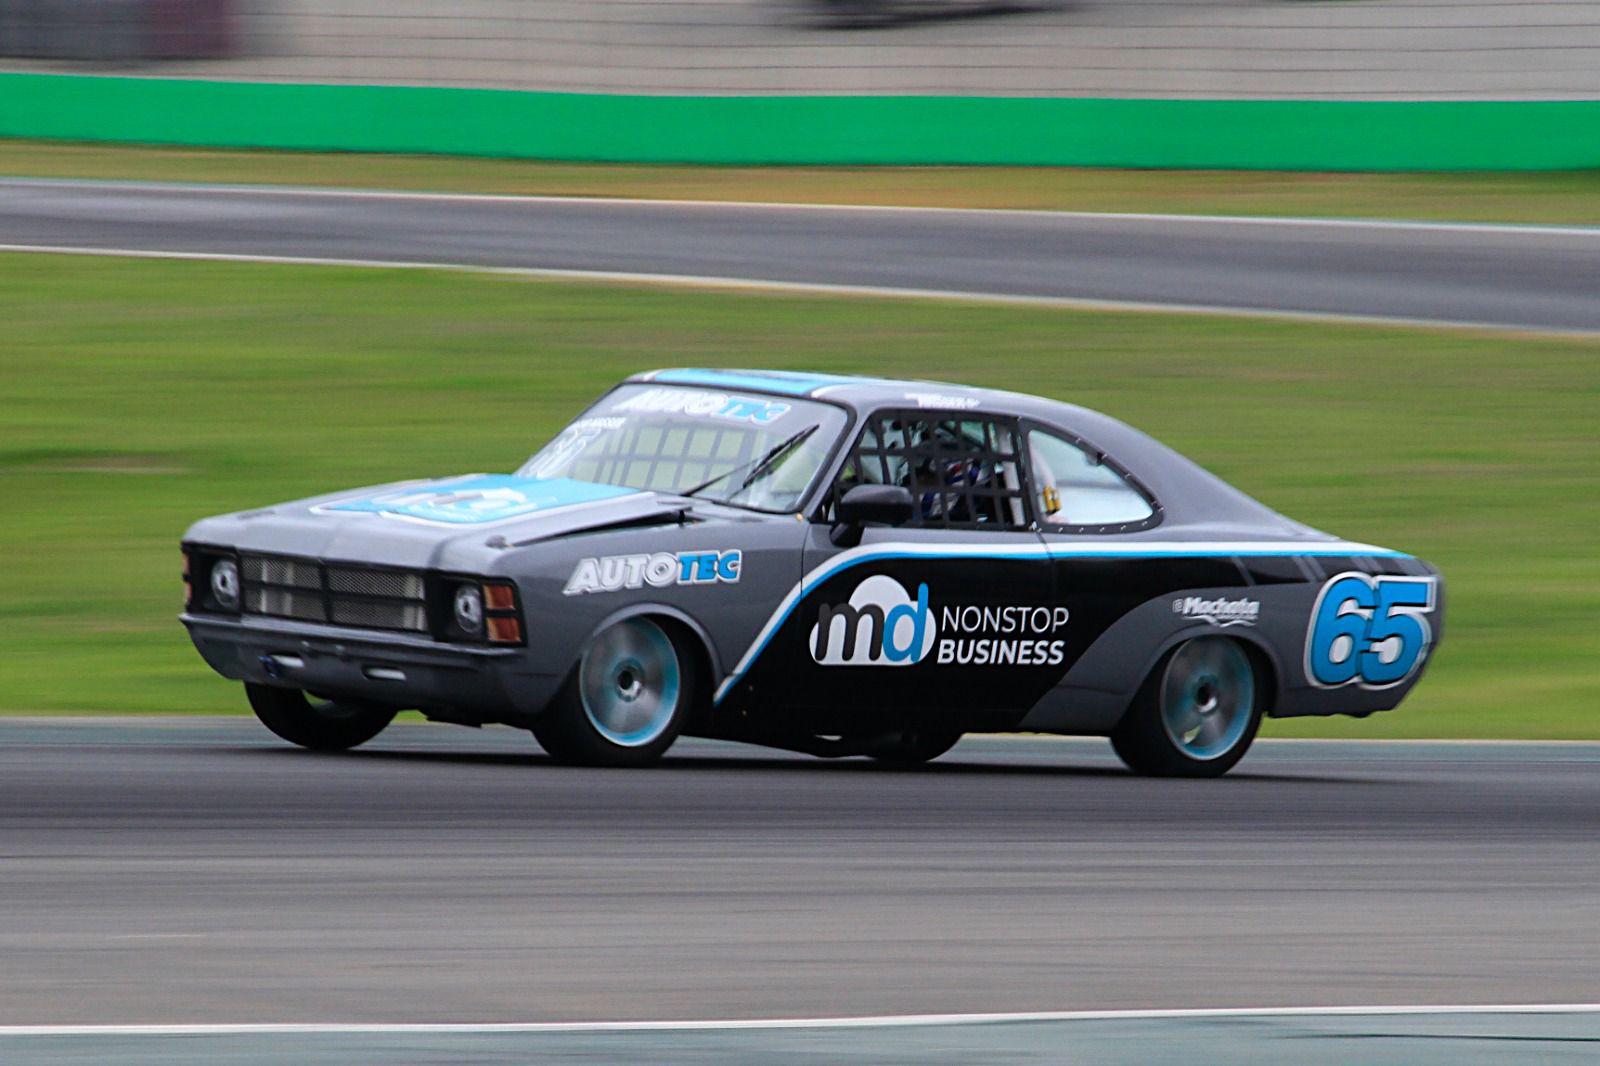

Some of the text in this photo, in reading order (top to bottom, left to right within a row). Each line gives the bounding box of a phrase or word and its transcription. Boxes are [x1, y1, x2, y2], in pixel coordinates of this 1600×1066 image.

[562, 549, 742, 597] AUTOTEC
[814, 582, 929, 664] md
[941, 605, 1070, 634] NONSTOP
[1304, 571, 1438, 690] 65
[936, 639, 1065, 665] BUSINESS
